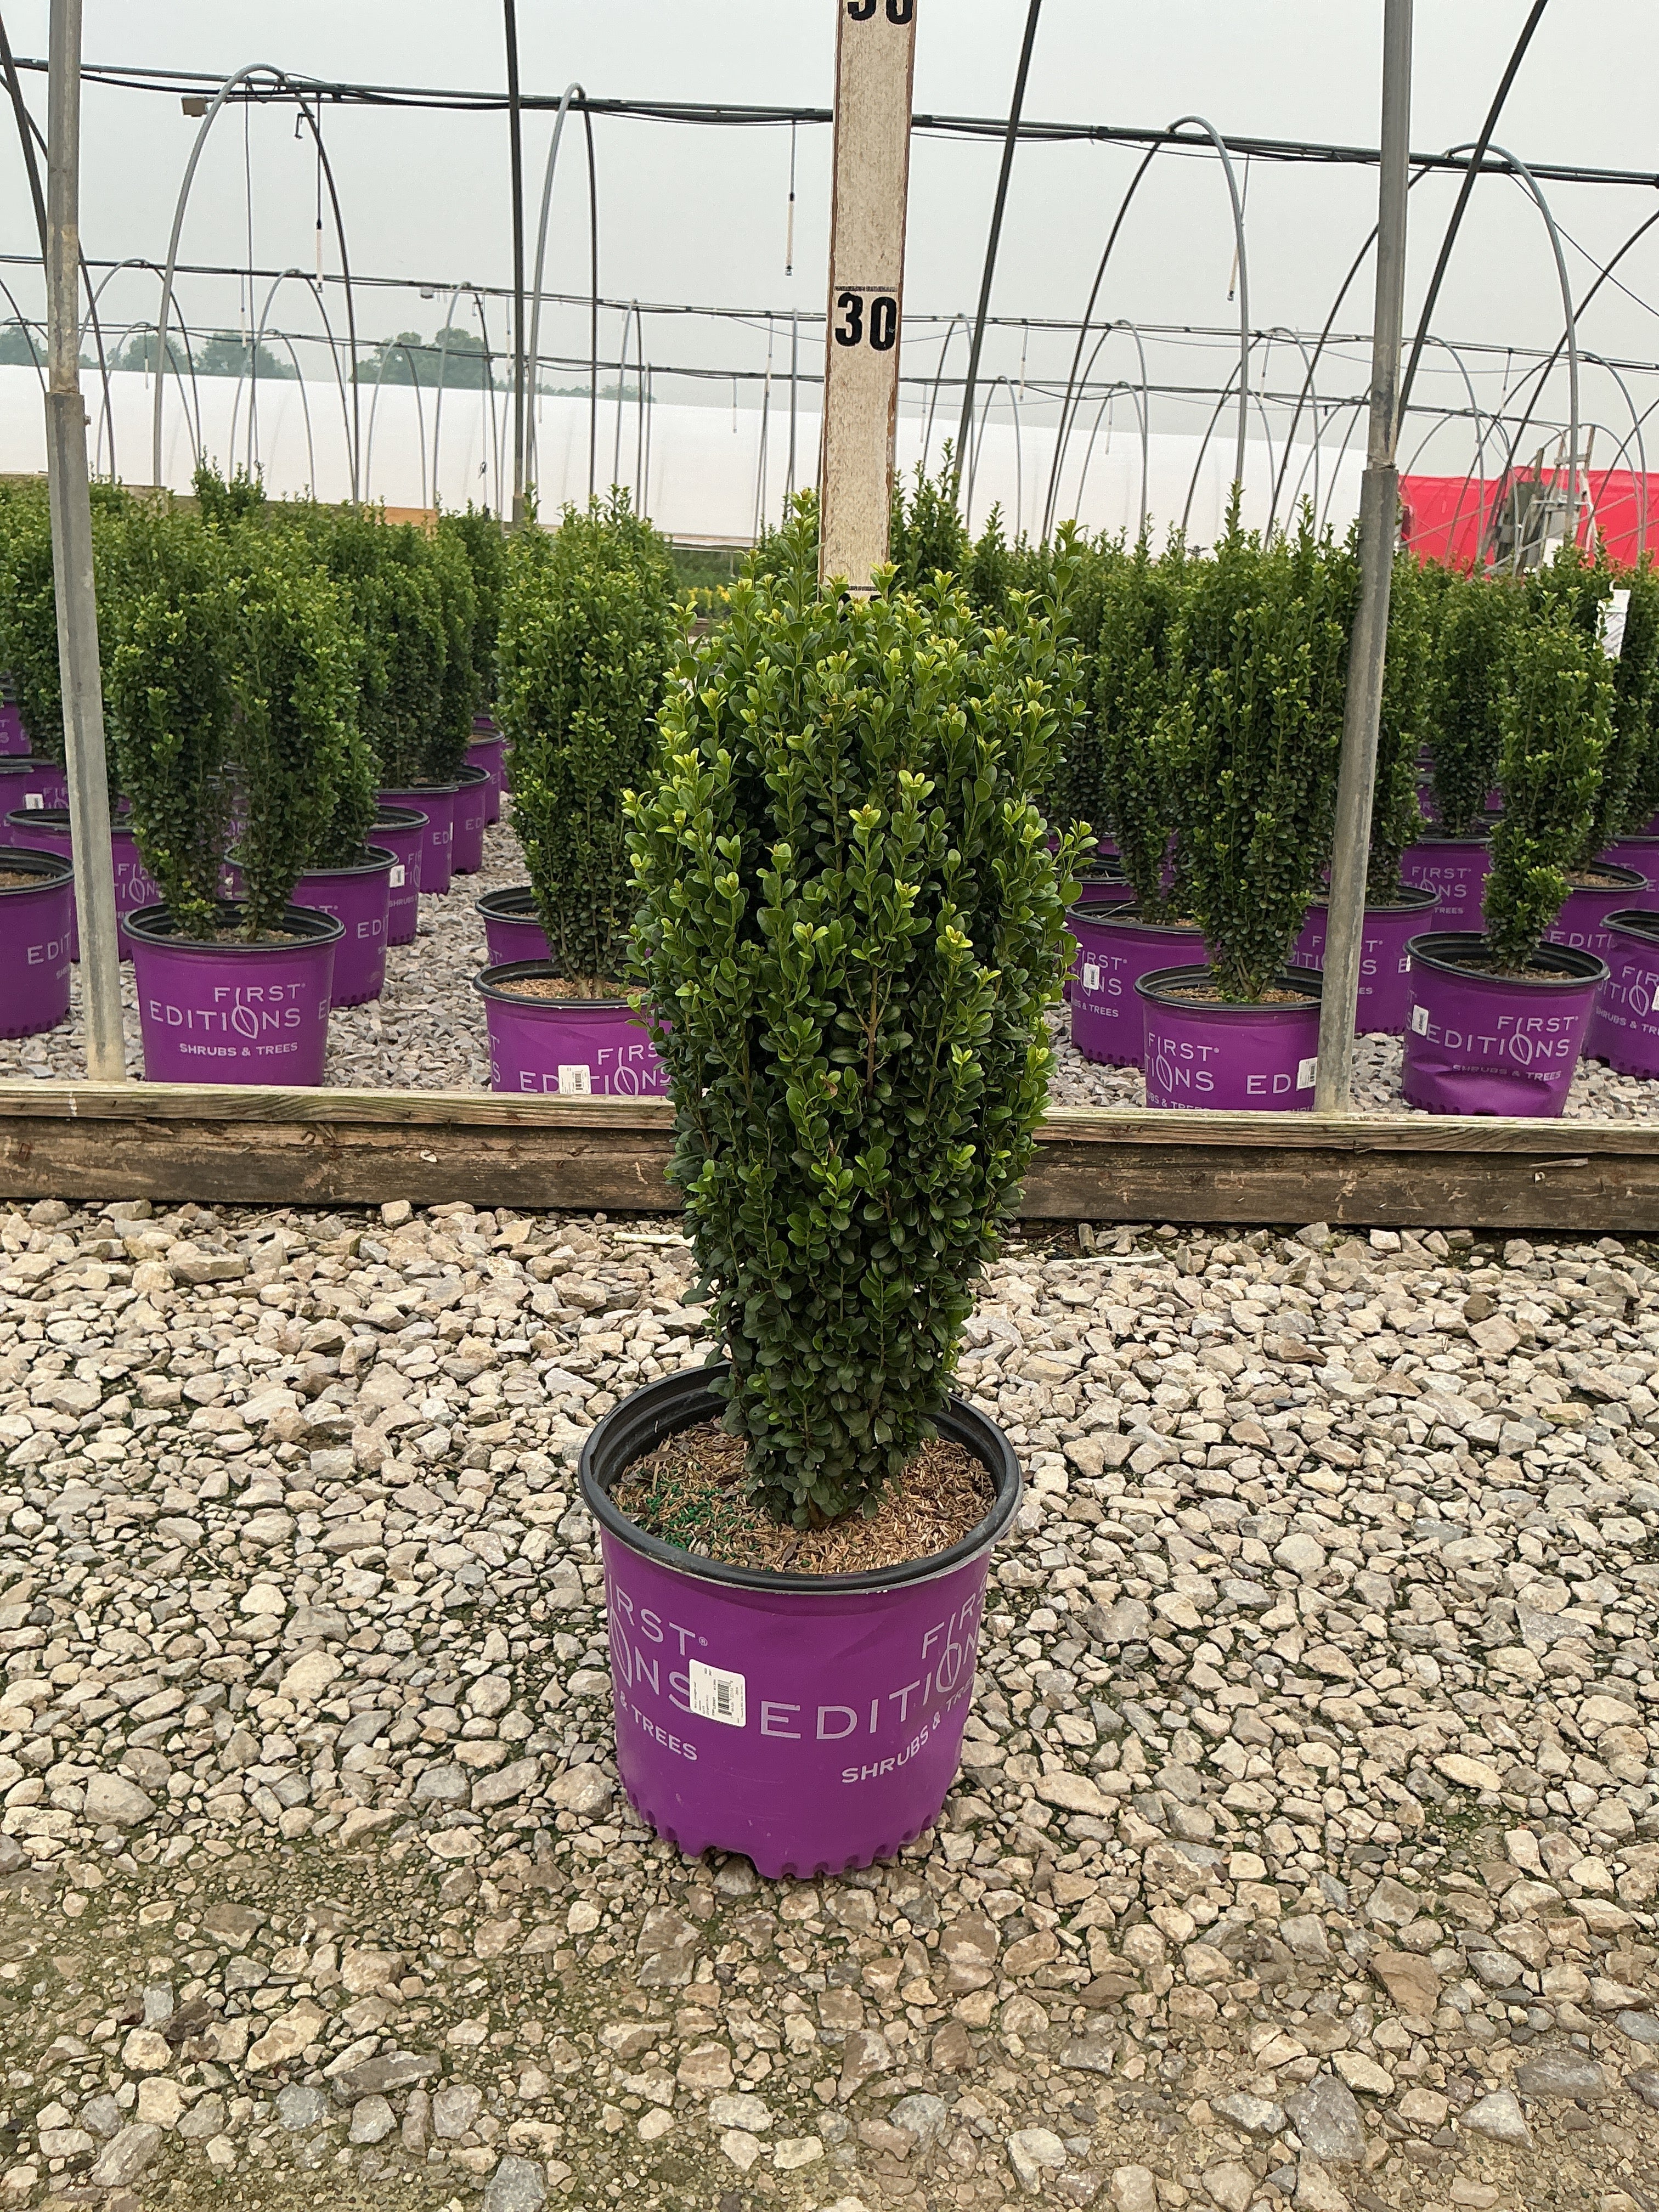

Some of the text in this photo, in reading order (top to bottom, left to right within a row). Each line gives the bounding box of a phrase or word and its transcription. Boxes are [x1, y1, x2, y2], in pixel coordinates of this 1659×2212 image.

[835, 292, 898, 351] 30
[1434, 906, 1464, 915] TREES
[150, 1000, 301, 1039] EDITIONS
[1088, 1004, 1119, 1018] TREES
[179, 1042, 298, 1057] SHRUBS & TREES
[1426, 1024, 1571, 1065] EDITIONS
[1526, 1070, 1562, 1081] TREES
[760, 1616, 981, 1740] EDITION
[631, 1703, 698, 1761] TREES
[841, 1724, 929, 1783] SHRUBS
[932, 1711, 941, 1730] &
